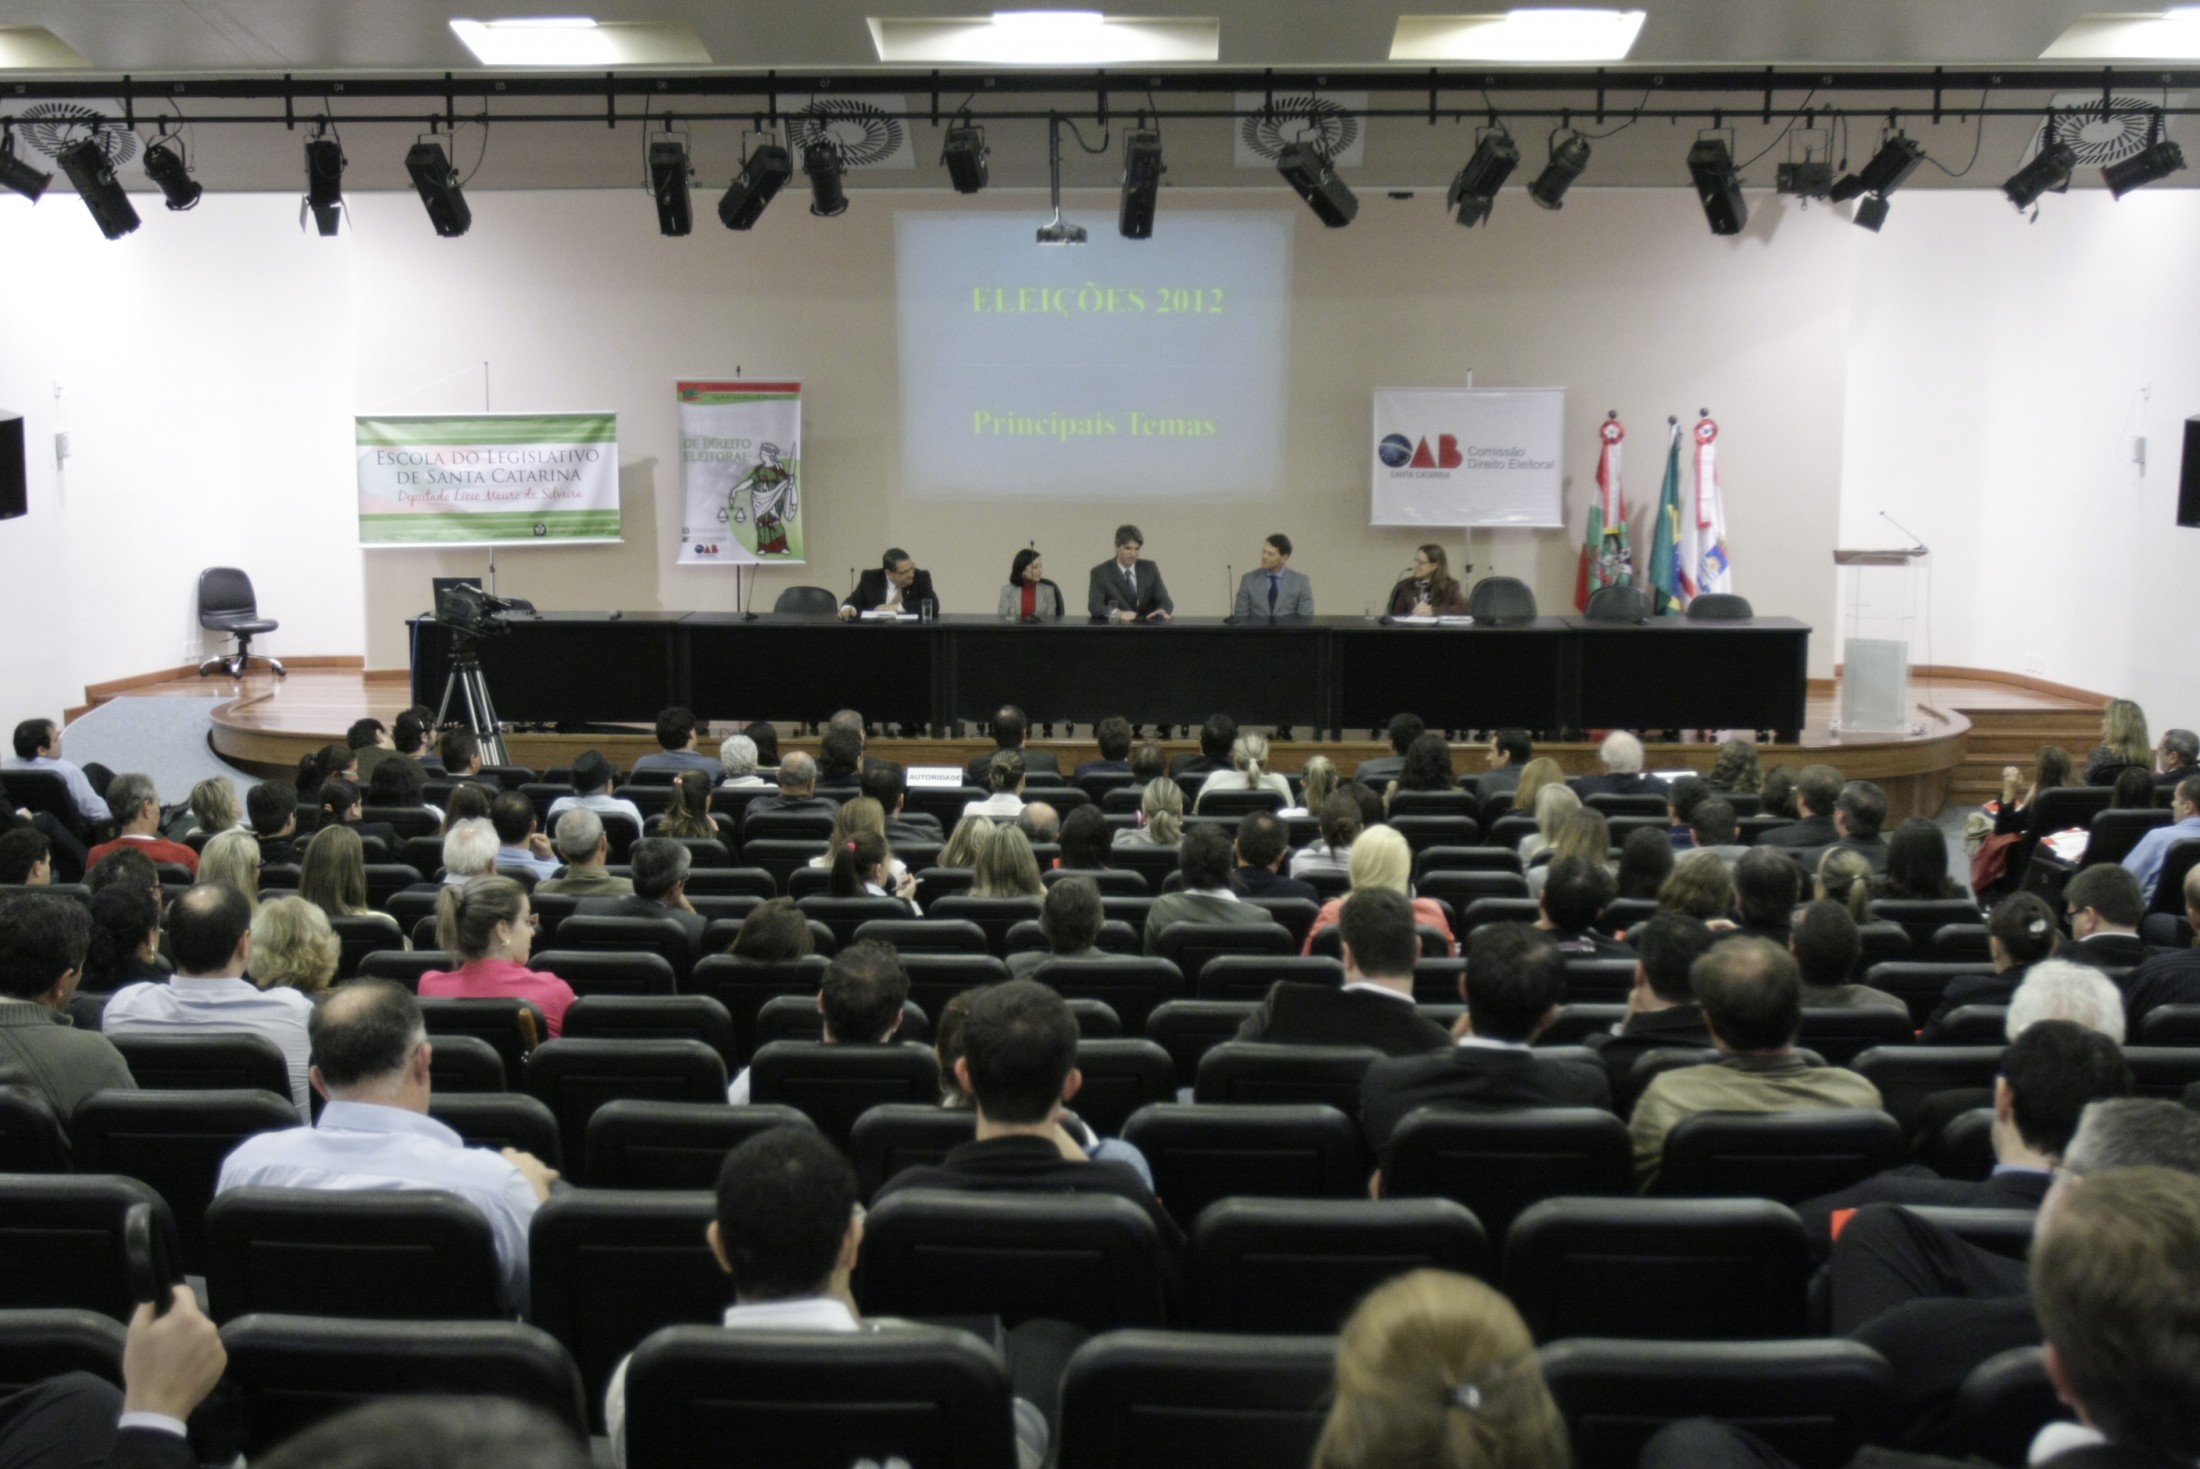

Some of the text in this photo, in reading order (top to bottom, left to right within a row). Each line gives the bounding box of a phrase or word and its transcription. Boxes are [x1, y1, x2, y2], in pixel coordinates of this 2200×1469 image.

[334, 83, 345, 92] 04
[495, 81, 506, 91] 05
[656, 80, 668, 90] 06
[820, 79, 831, 89] 07
[984, 78, 996, 88] 08
[1150, 77, 1162, 87] 09
[972, 280, 1224, 318] ELEIÇÕES 2012
[972, 410, 1217, 443] Principais Temas
[703, 438, 751, 450] DIREITO
[376, 448, 599, 466] ESCOLA DO LEGISLATIVO
[684, 451, 748, 463] ELEITORAL
[1378, 433, 1463, 469] OAB
[1467, 446, 1526, 458] Comissão
[1467, 459, 1556, 470] Direito Eleitoral
[397, 467, 582, 485] DE SANTA CATARINA
[398, 488, 449, 508] Deputado
[909, 773, 961, 782] AUTORIDADE
